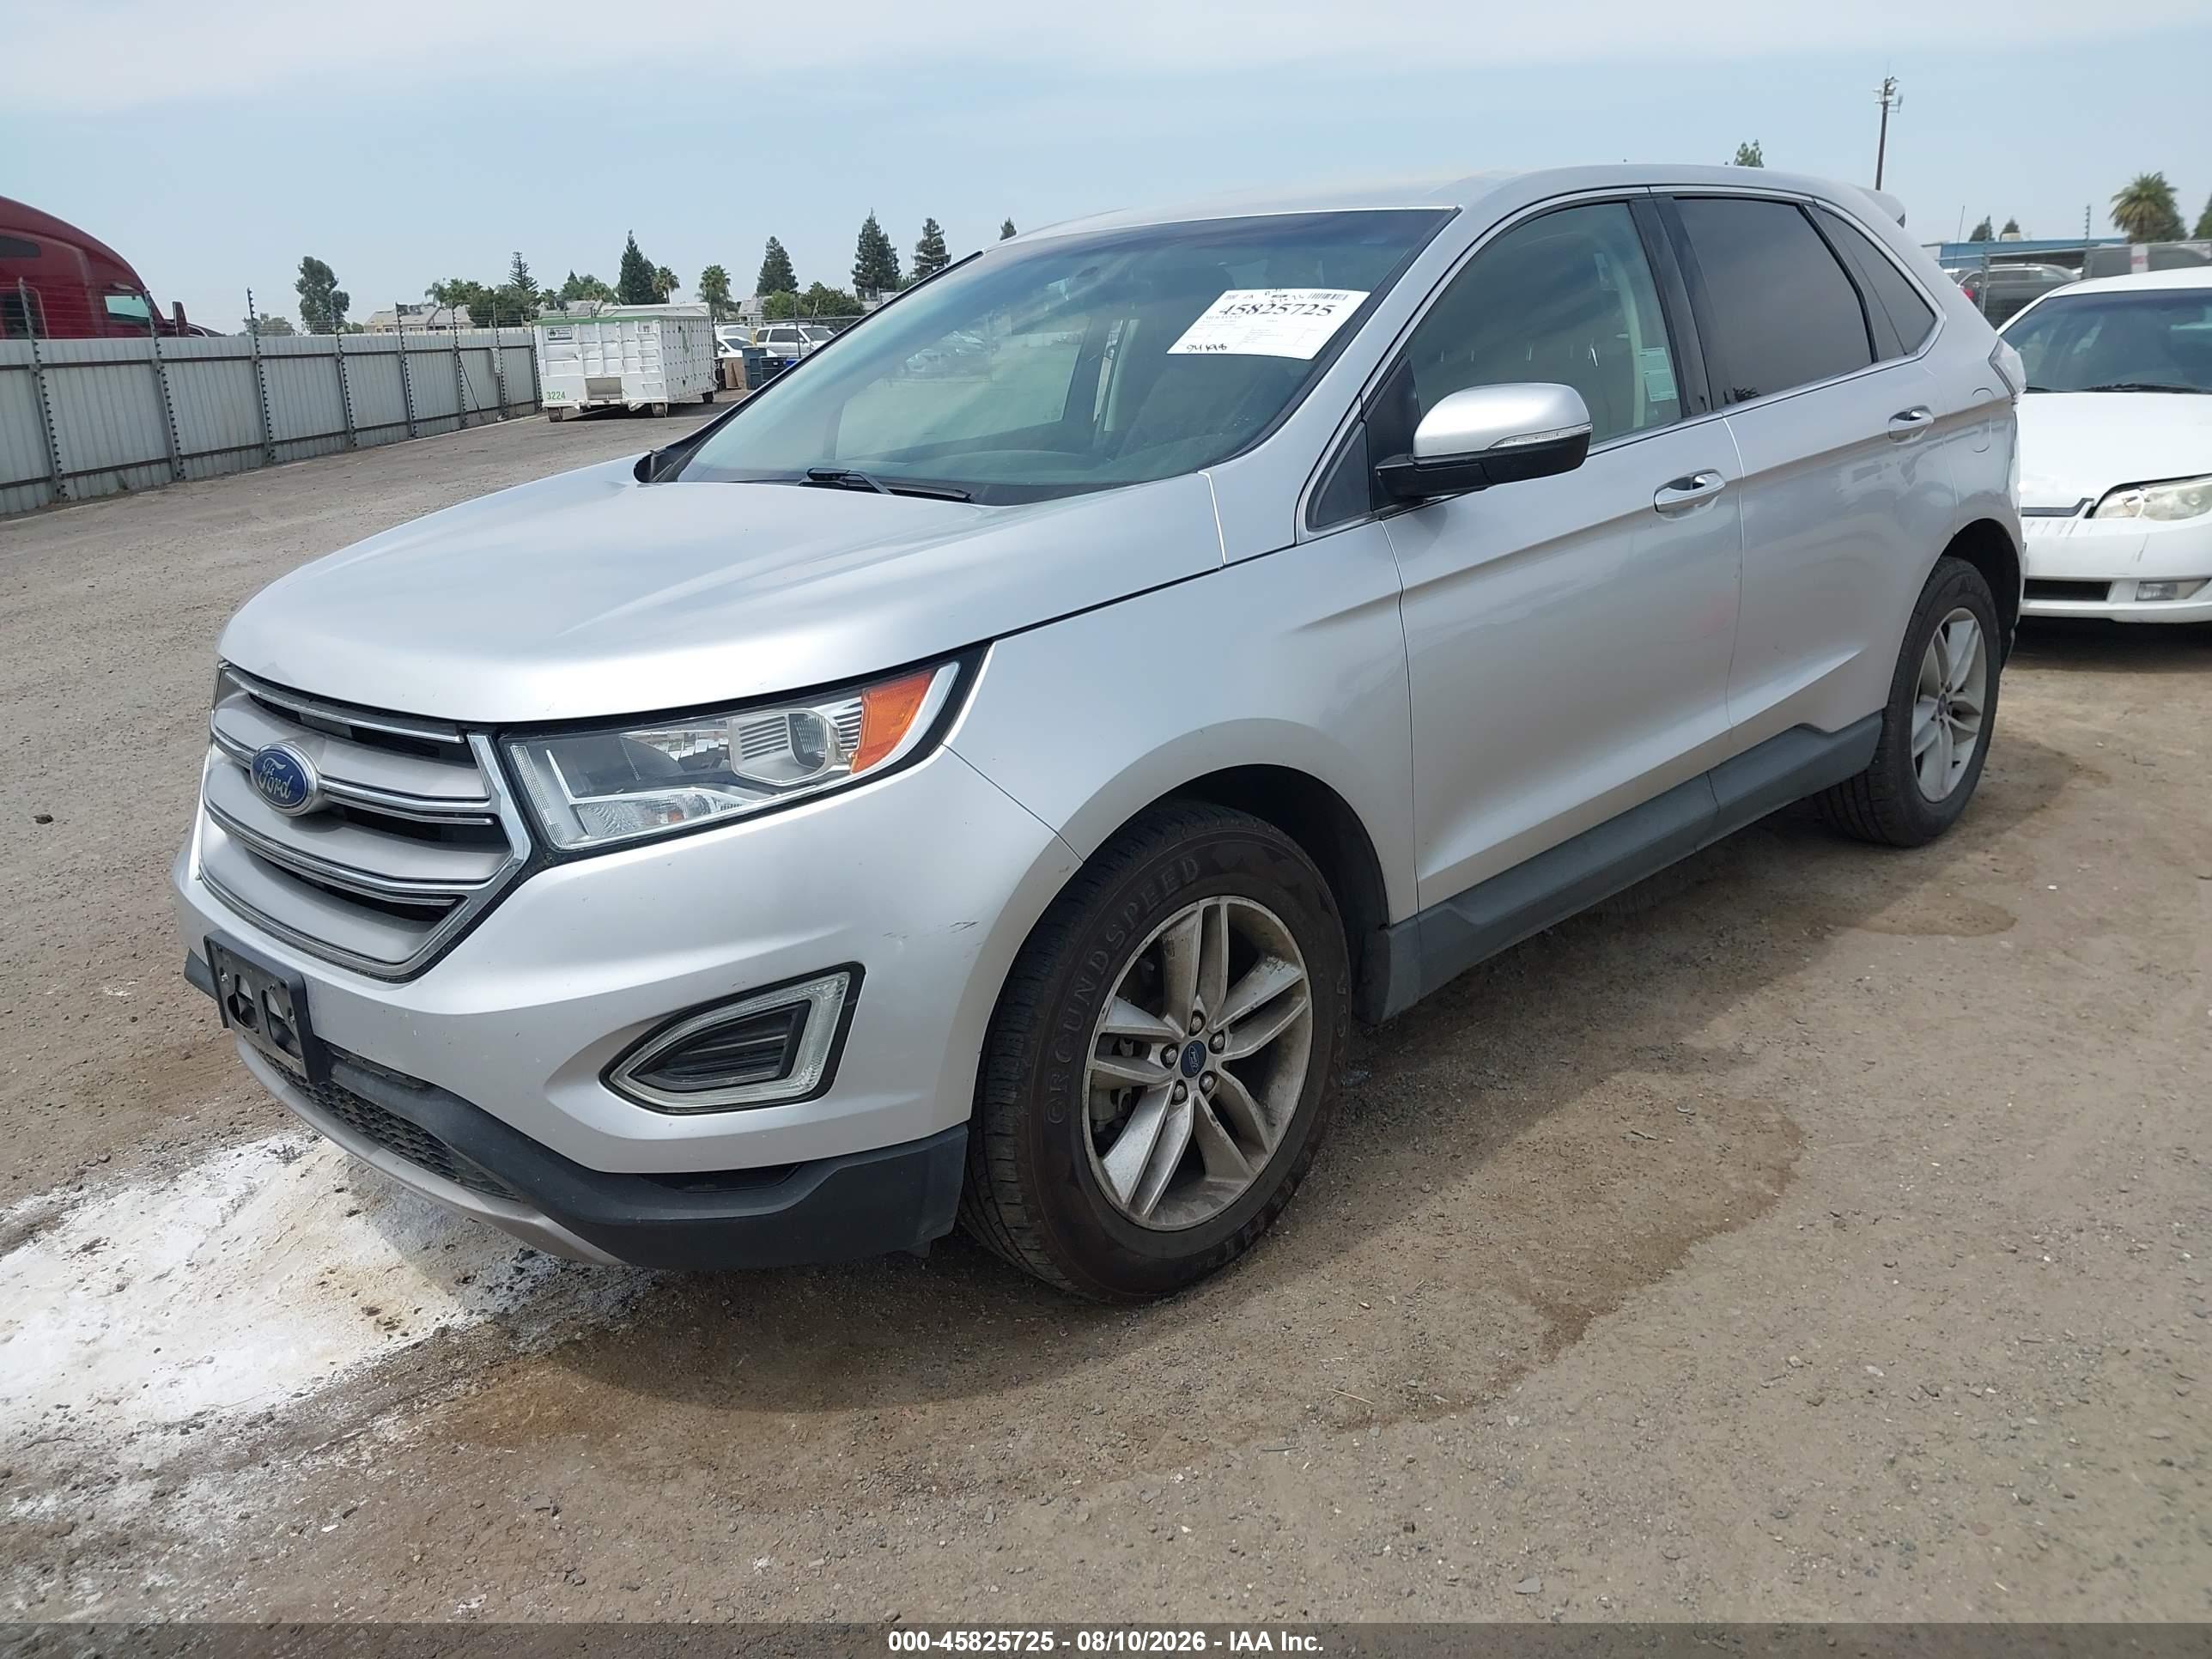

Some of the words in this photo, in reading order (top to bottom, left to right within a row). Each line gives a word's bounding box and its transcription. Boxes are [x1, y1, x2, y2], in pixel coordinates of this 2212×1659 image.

[1218, 303, 1338, 317] 45825725
[546, 391, 566, 400] 3224
[258, 757, 294, 799] Ford
